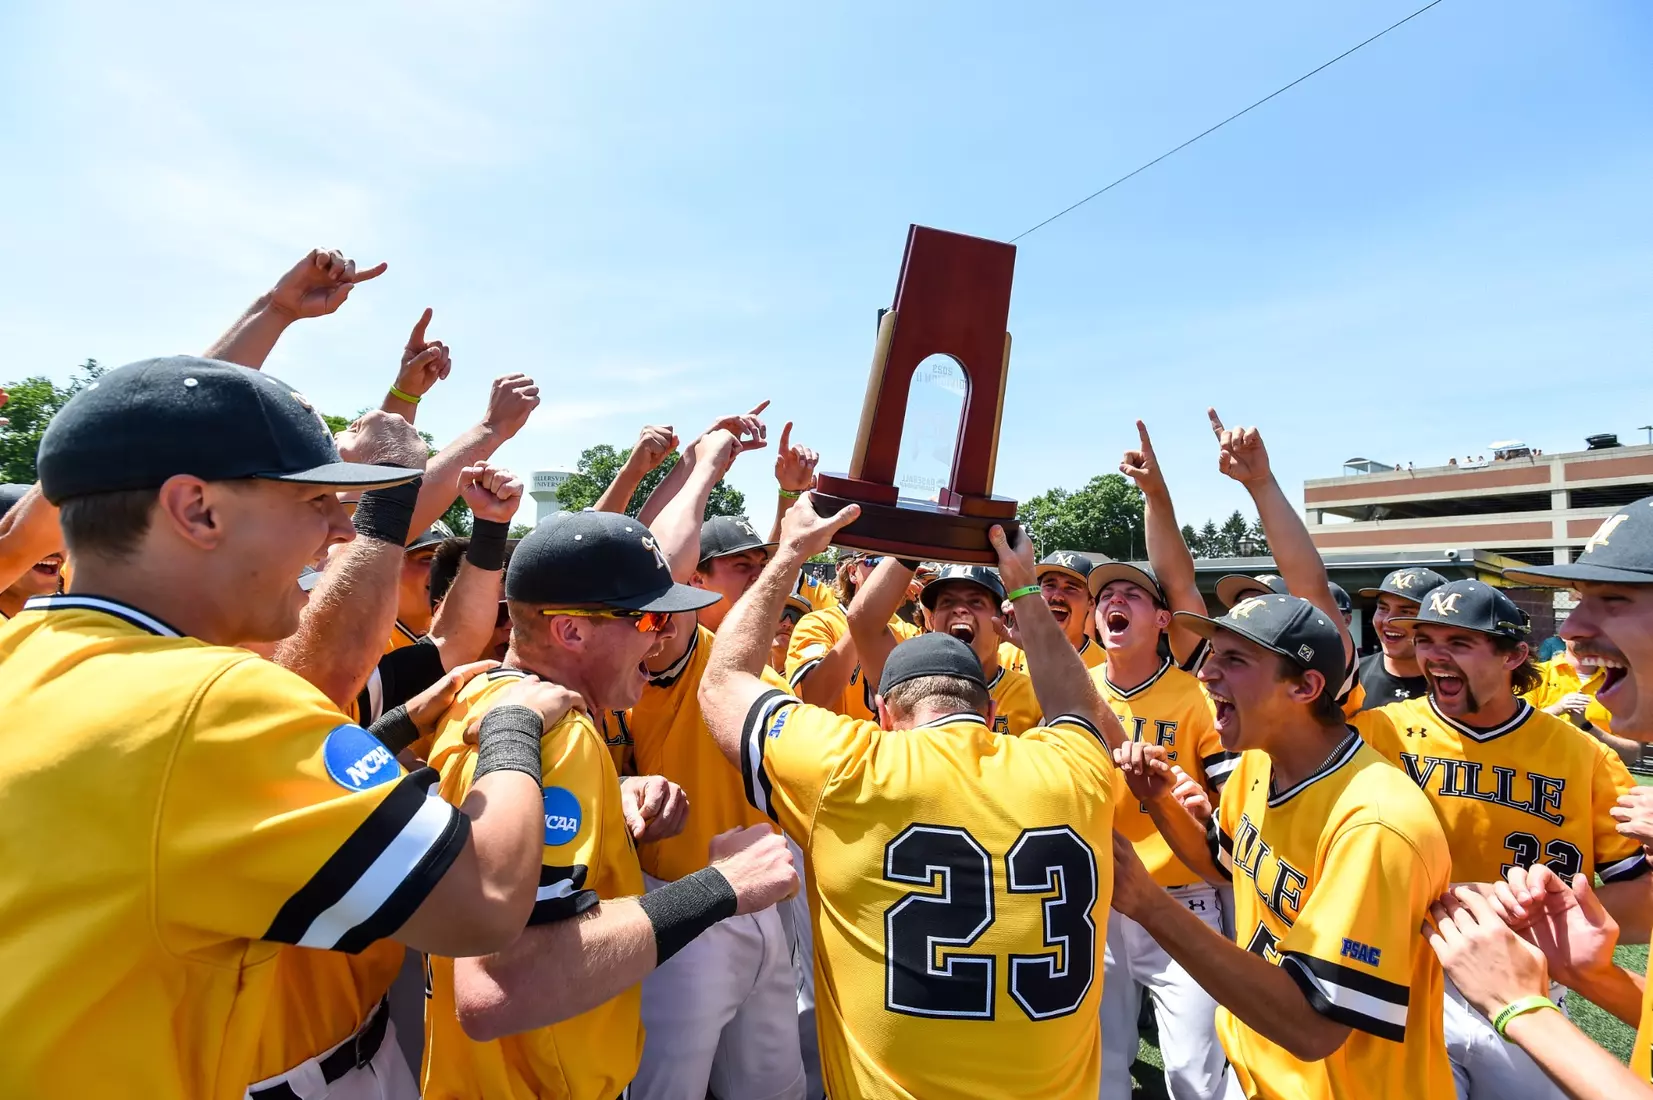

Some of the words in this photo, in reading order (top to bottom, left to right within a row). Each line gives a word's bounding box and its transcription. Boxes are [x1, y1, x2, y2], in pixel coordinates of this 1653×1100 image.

[345, 745, 394, 787] NCAA
[1400, 752, 1566, 827] VILLE
[1500, 831, 1583, 888] 32
[883, 822, 1098, 1022] 23
[1340, 937, 1382, 967] PSAC
